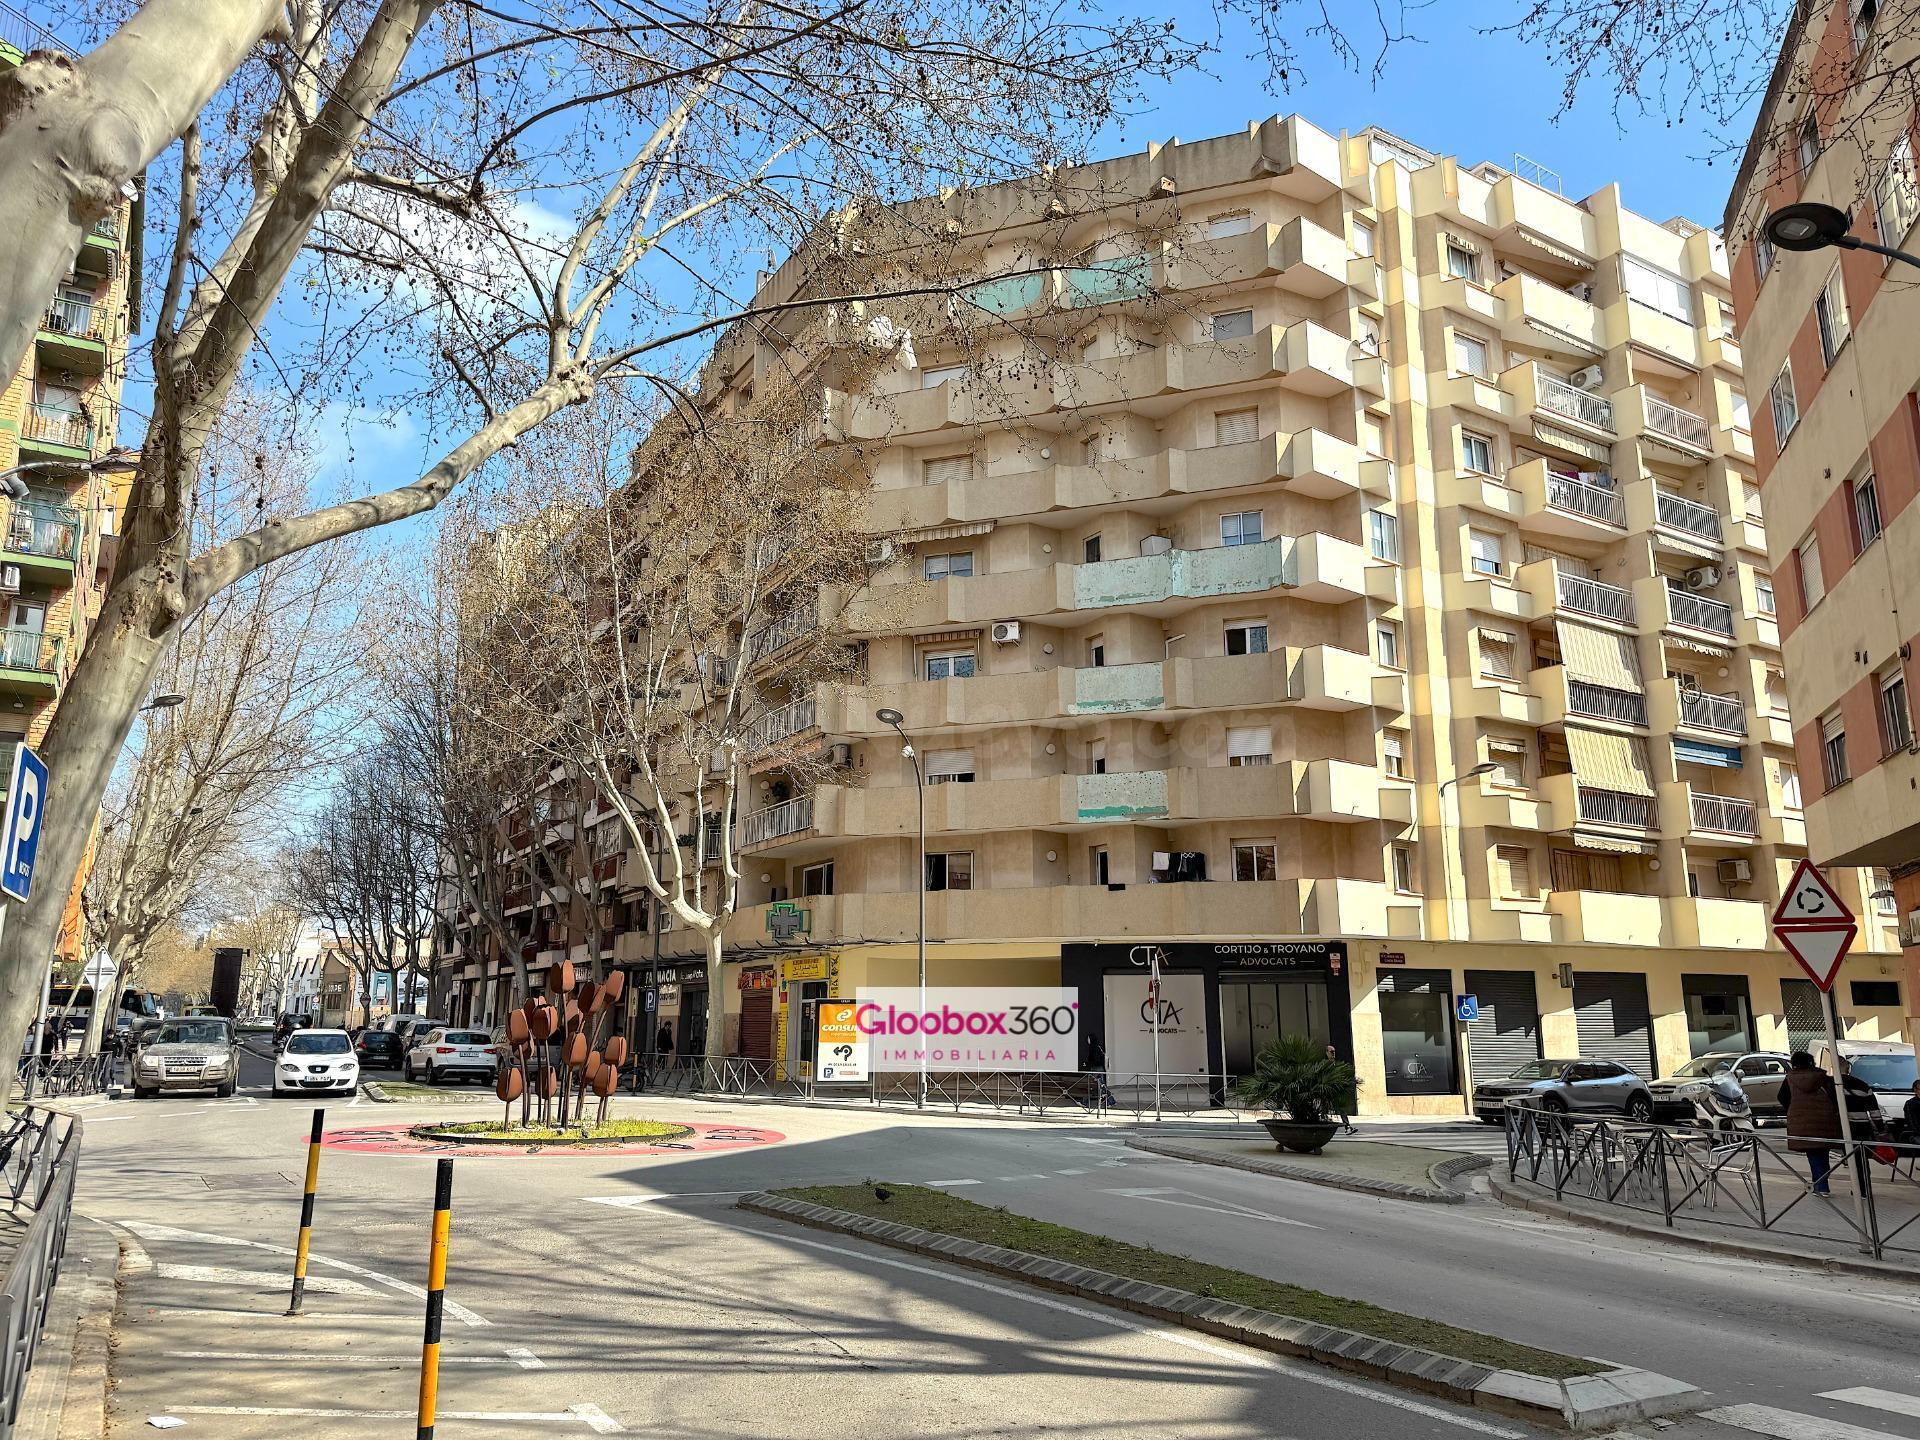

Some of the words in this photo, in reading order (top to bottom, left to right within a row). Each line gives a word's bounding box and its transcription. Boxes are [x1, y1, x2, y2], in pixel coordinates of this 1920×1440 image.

[1129, 945, 1173, 966] CTA
[1214, 945, 1262, 954] CORTIJO
[1270, 944, 1326, 954] TROYANO
[1240, 957, 1297, 966] ADVOCATS
[645, 968, 677, 984] FAMACIA
